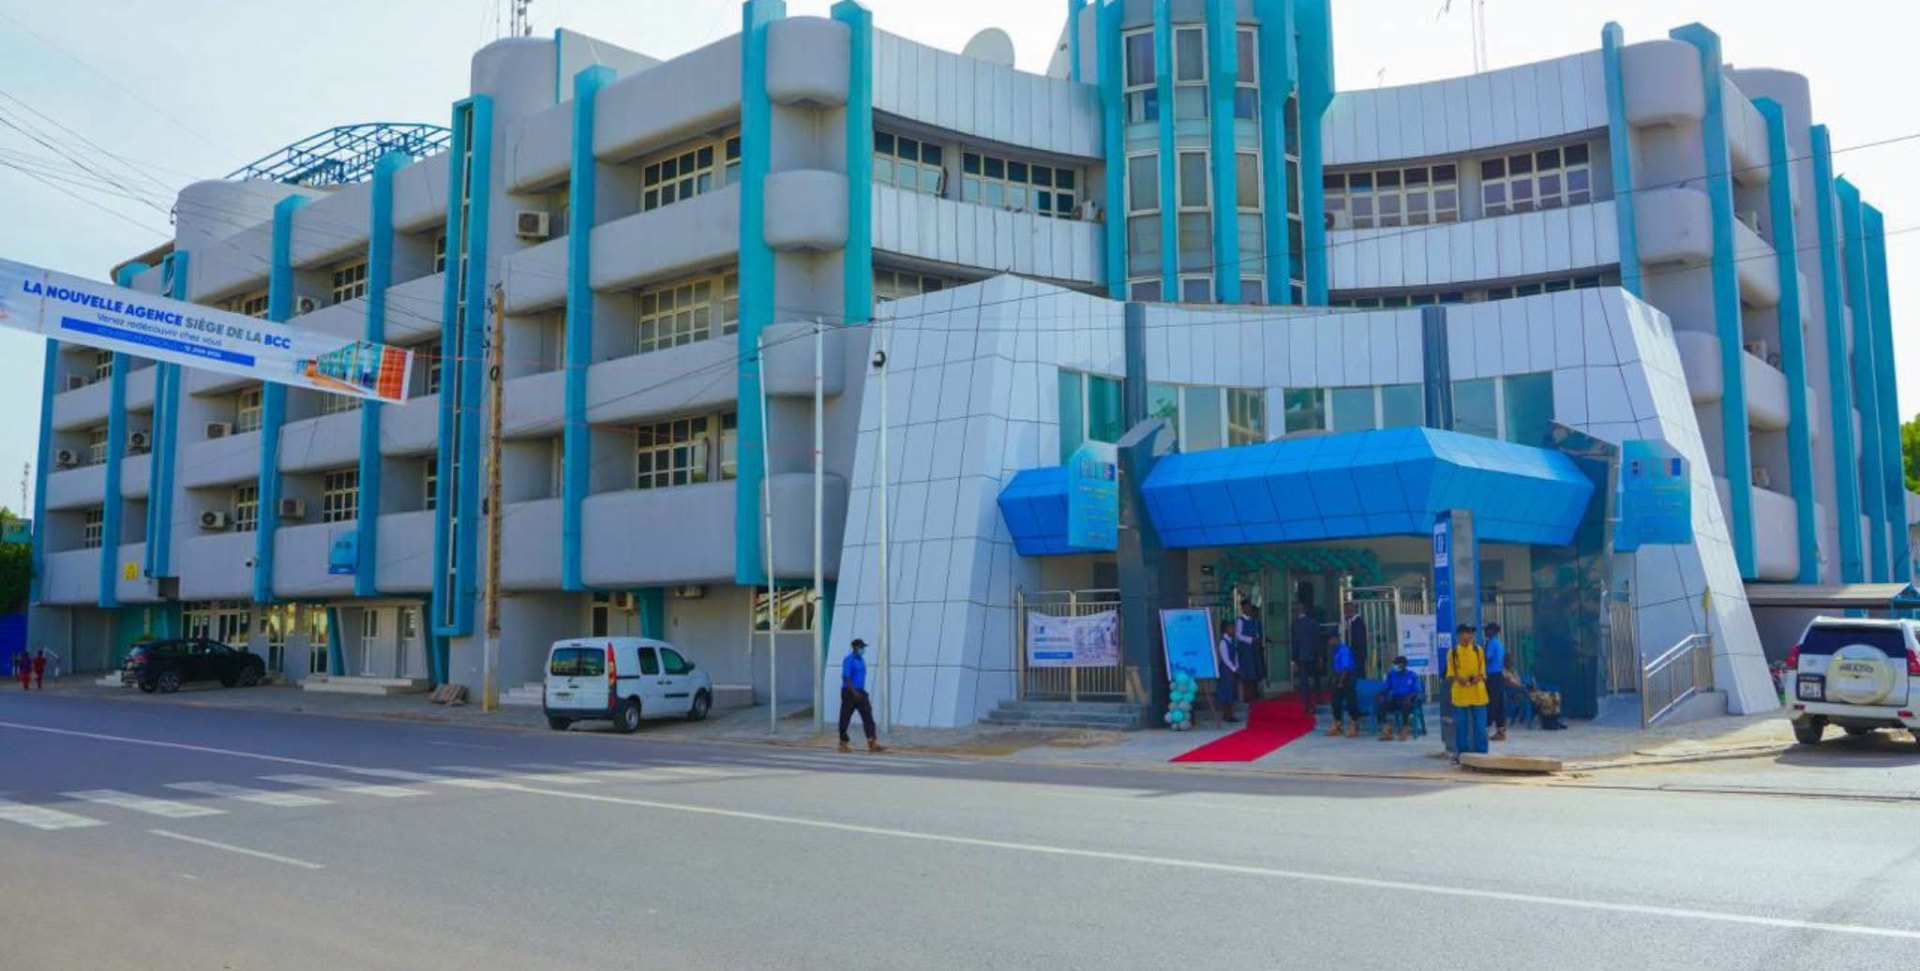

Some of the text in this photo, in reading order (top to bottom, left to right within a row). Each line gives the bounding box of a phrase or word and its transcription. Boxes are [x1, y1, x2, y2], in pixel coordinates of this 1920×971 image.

[23, 280, 42, 295] LA
[46, 285, 123, 313] NOUVELLE
[125, 304, 183, 326] AGENCE
[226, 326, 243, 339] DE
[246, 331, 261, 343] LA
[264, 334, 291, 349] BCC
[97, 313, 124, 326] Venez
[180, 330, 200, 343] chez
[202, 336, 222, 346] vous
